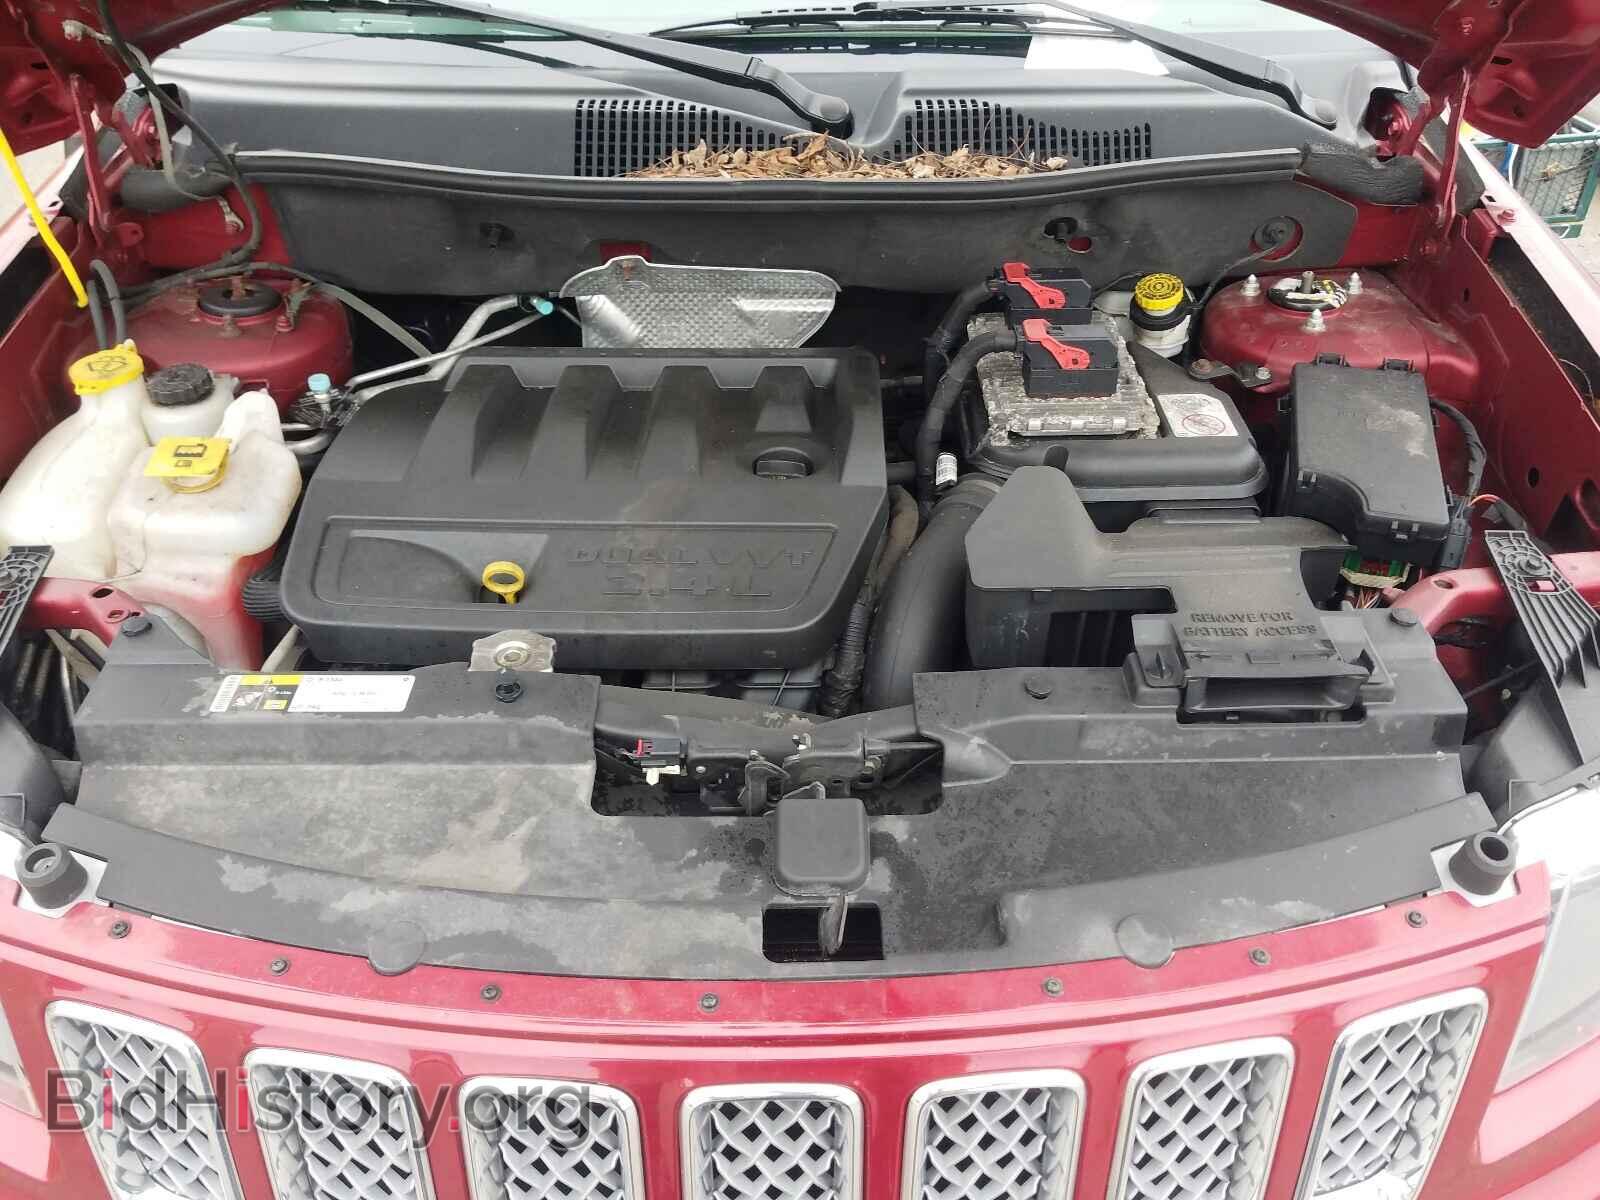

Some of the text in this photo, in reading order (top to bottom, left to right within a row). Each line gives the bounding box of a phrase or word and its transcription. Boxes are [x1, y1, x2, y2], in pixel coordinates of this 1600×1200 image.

[566, 547, 813, 568] DUAL VVT
[1190, 611, 1295, 624] REMOVE FOR
[1183, 624, 1318, 638] BATTERY ACCESS
